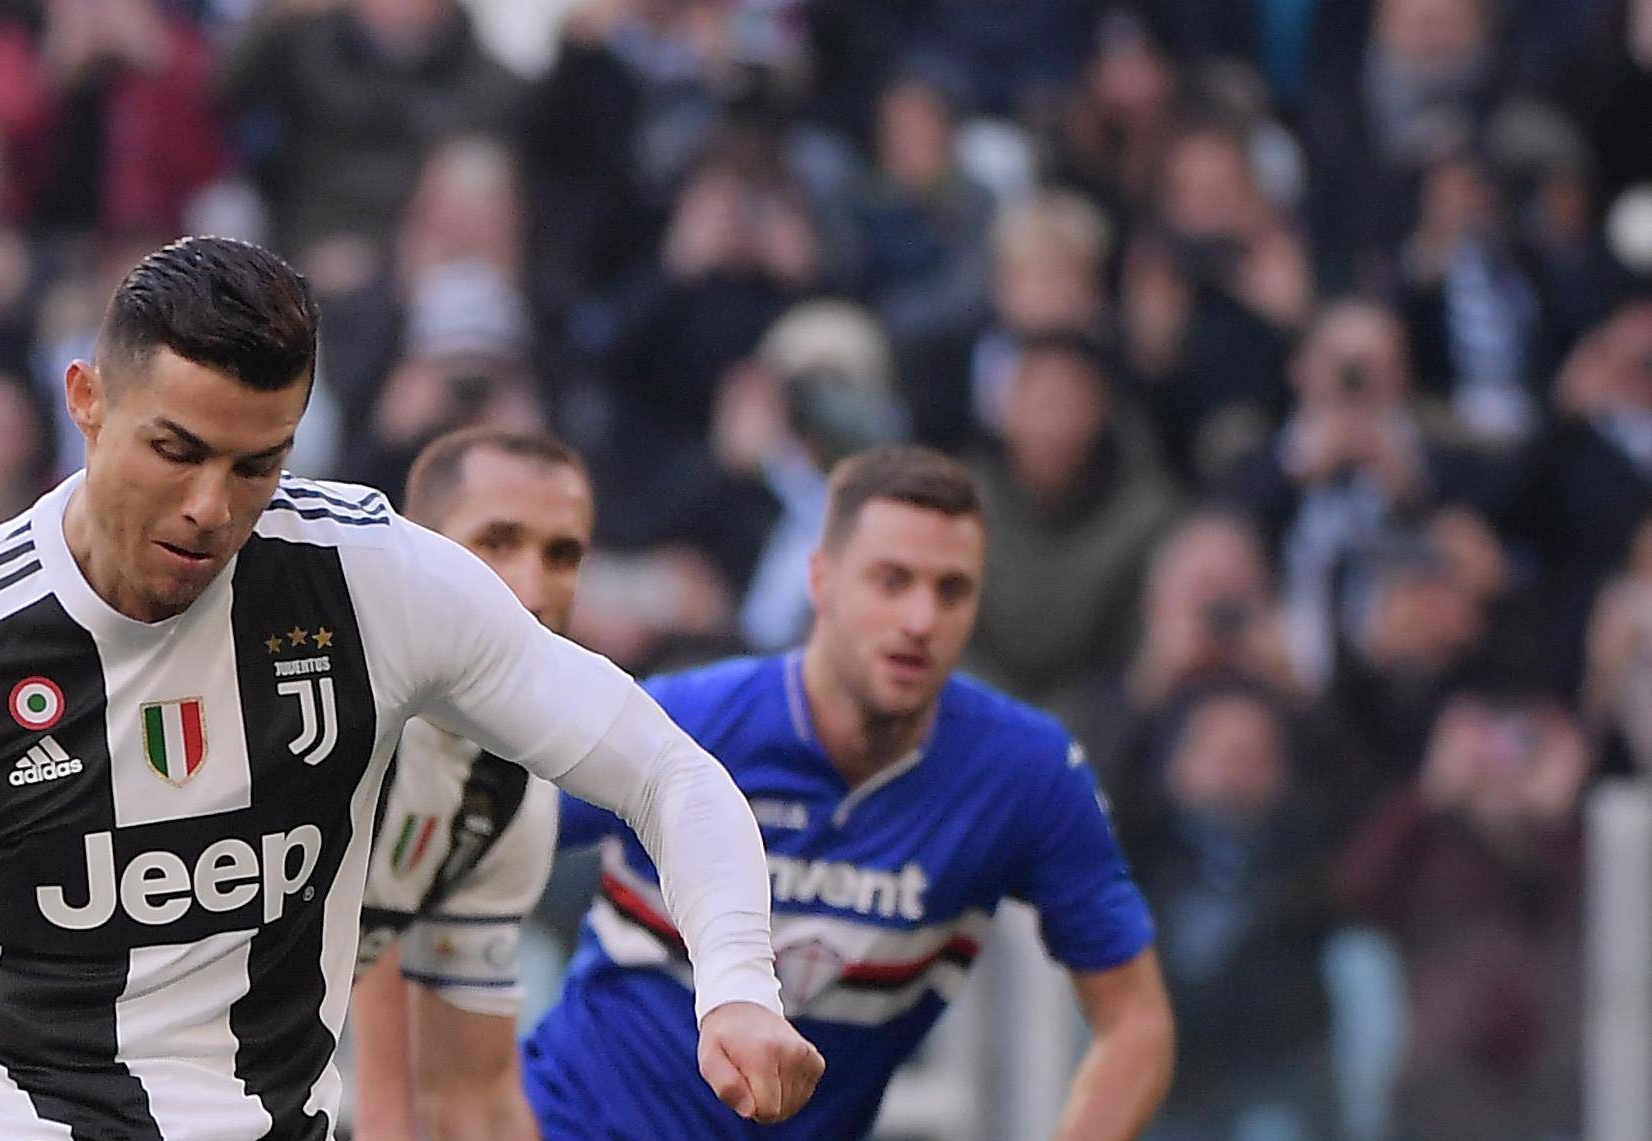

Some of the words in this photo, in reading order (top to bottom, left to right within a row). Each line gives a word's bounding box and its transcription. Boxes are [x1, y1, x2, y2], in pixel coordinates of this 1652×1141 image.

[274, 656, 331, 677] JUVENTUS
[9, 758, 83, 786] adidas
[36, 824, 324, 931] Jeep
[767, 852, 928, 921] nvent
